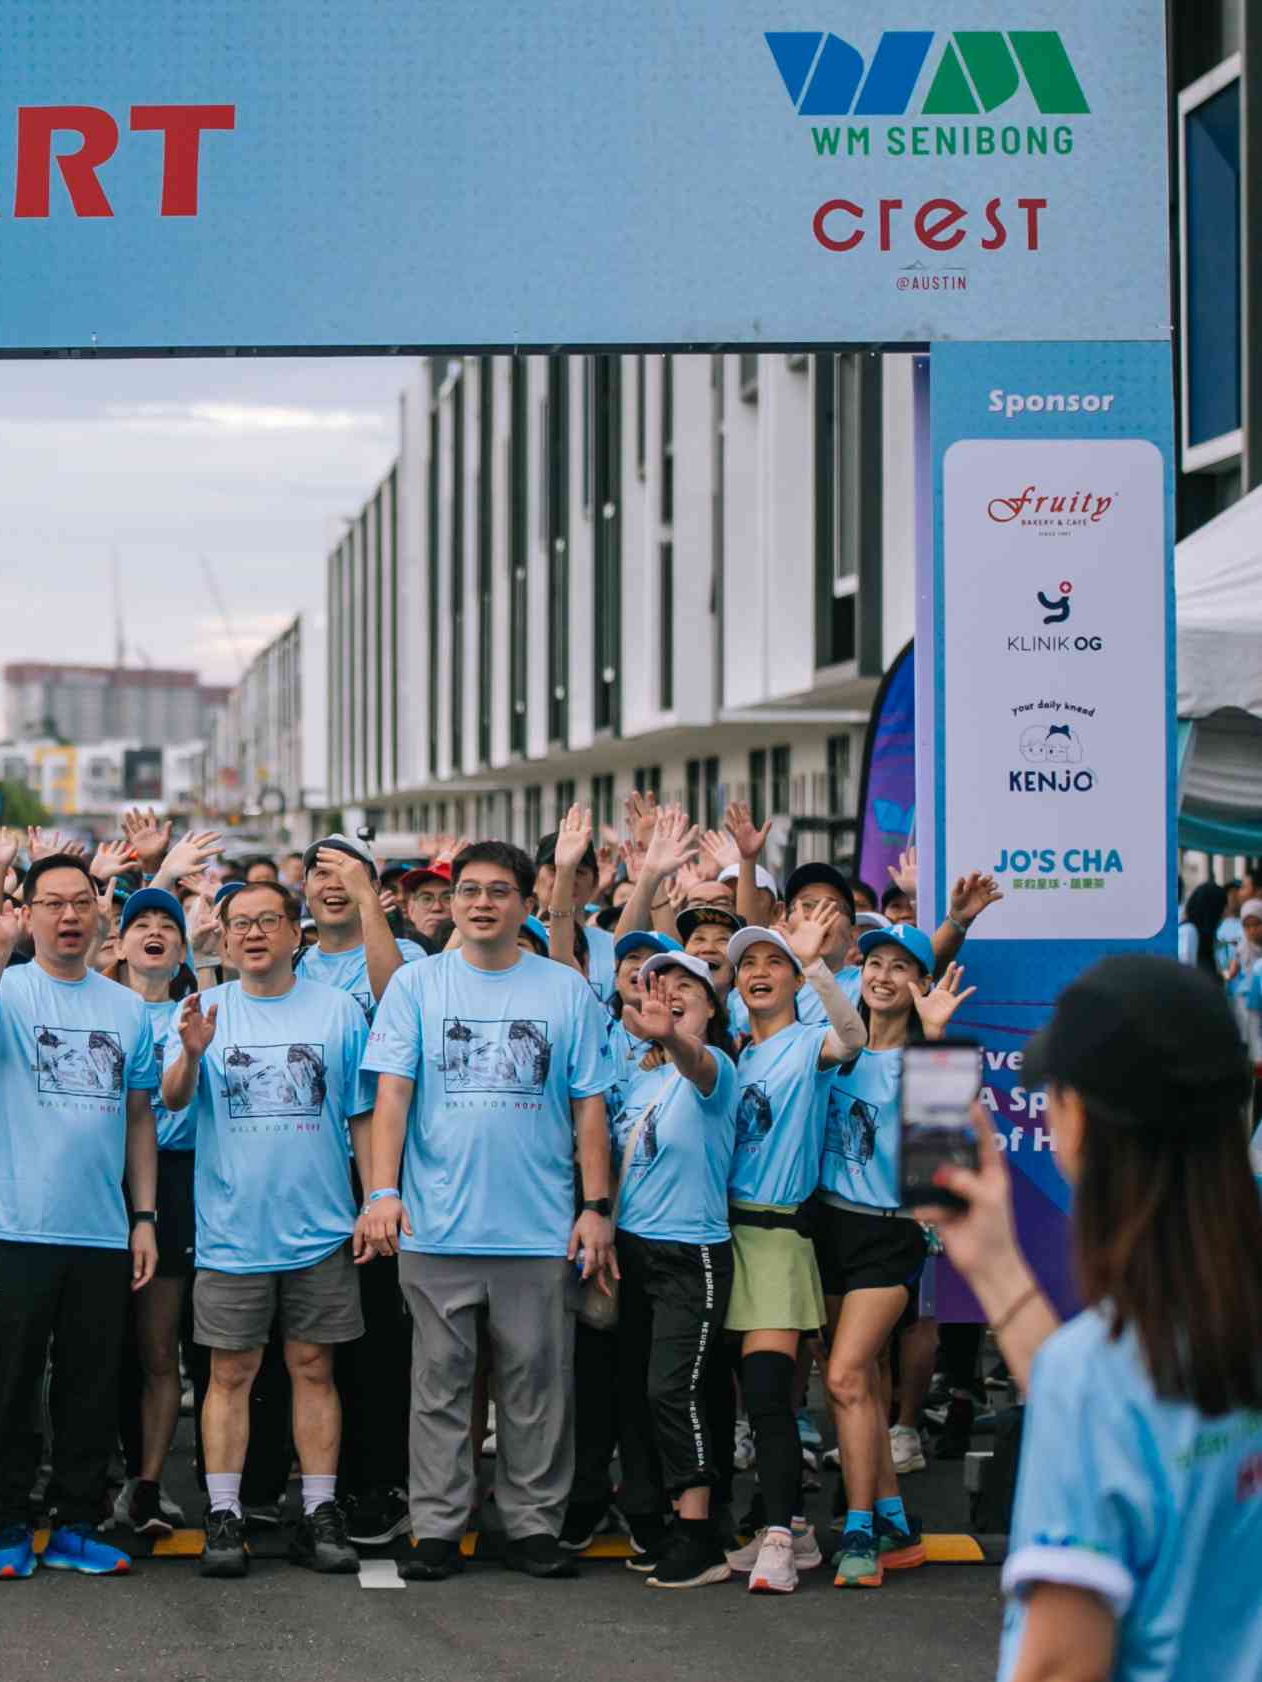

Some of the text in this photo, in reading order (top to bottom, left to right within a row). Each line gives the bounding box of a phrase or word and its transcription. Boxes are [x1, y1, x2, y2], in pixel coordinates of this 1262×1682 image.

[812, 126, 1074, 156] WM SENIBONG
[896, 275, 967, 291] @AUSTIN
[988, 389, 1115, 418] Sponsor
[1007, 636, 1103, 651] KLINIK OG
[1011, 699, 1097, 717] your daily knead
[994, 849, 1123, 872] JO'S CHA
[978, 1046, 1025, 1071] ive
[978, 1086, 1049, 1119] A Sp
[994, 1126, 1058, 1152] of H
